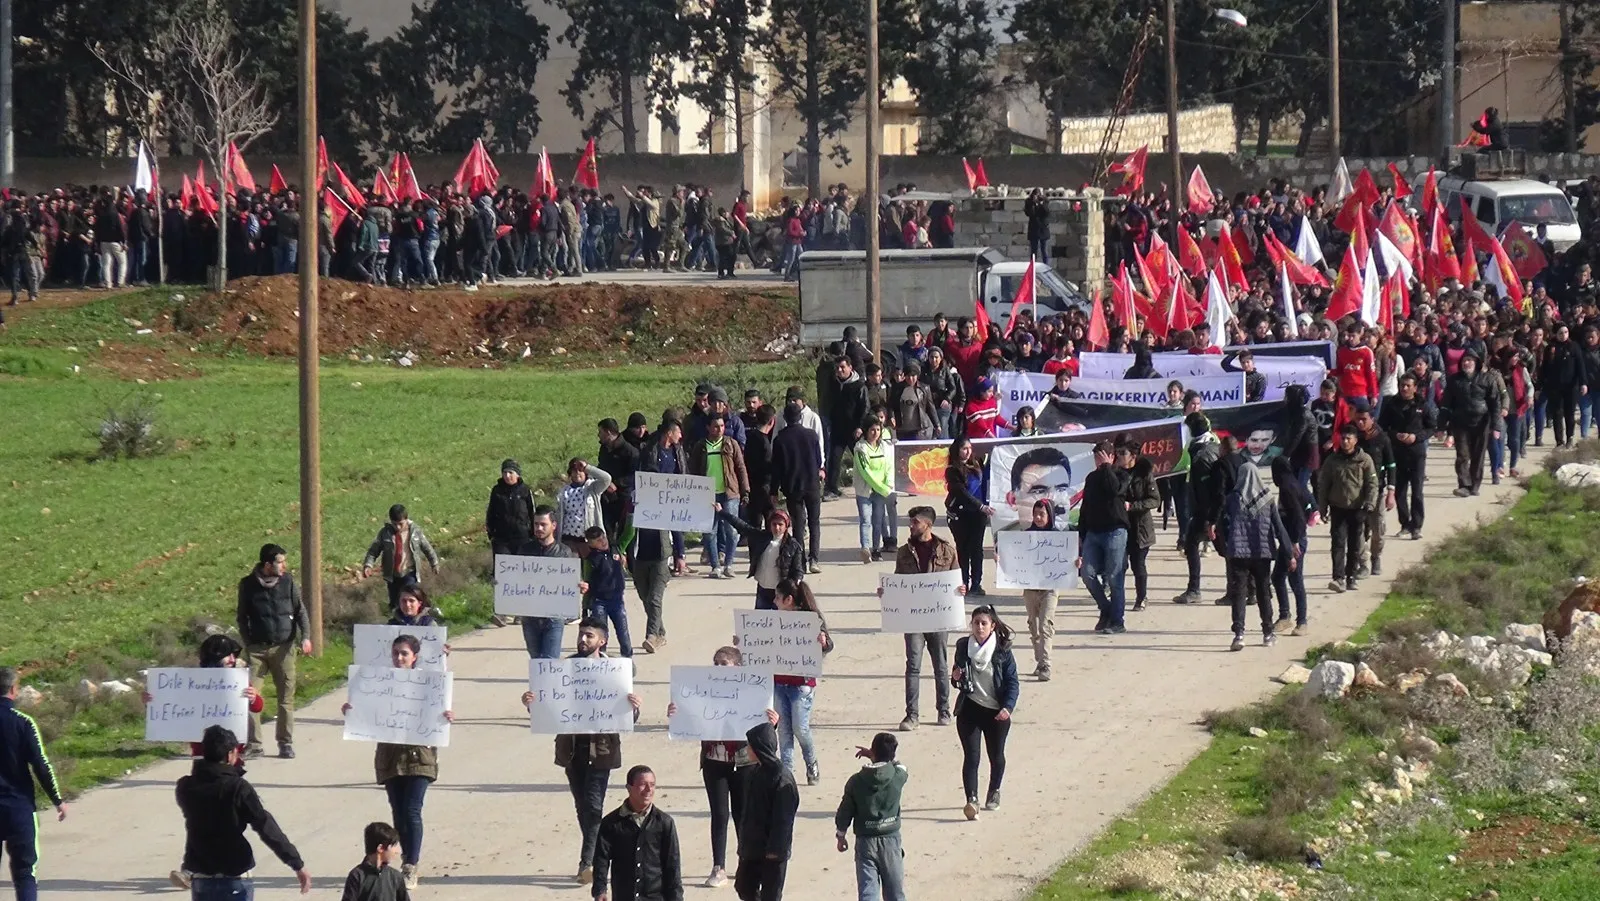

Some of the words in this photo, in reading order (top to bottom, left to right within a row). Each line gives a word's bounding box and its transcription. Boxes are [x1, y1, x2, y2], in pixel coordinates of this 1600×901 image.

[1079, 391, 1167, 403] AGIRKERIYA
[650, 477, 659, 487] bo
[549, 662, 563, 673] bo
[553, 688, 566, 700] bo
